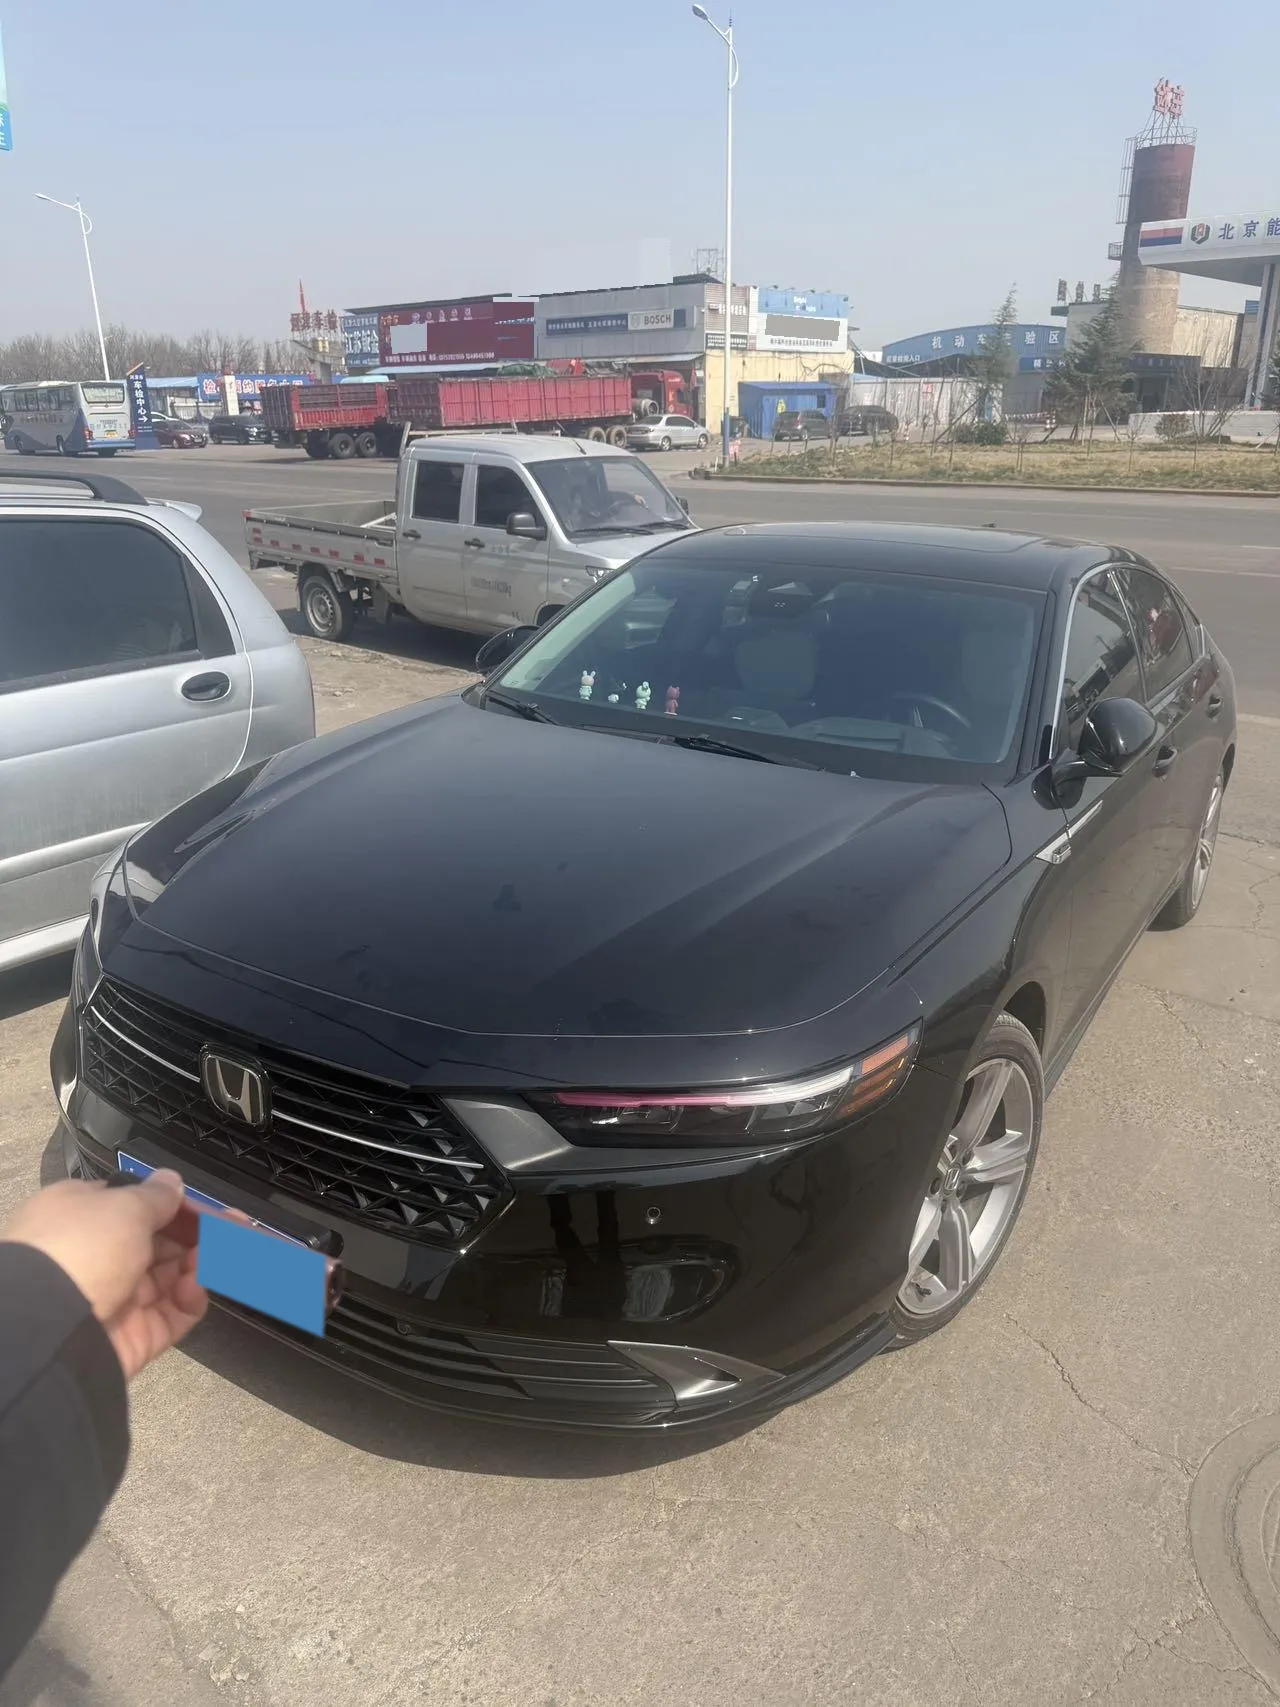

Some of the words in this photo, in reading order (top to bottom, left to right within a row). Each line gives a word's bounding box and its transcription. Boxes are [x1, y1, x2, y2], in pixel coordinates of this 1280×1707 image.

[644, 314, 672, 326] BOSCH
[133, 380, 148, 415] 车检中心
